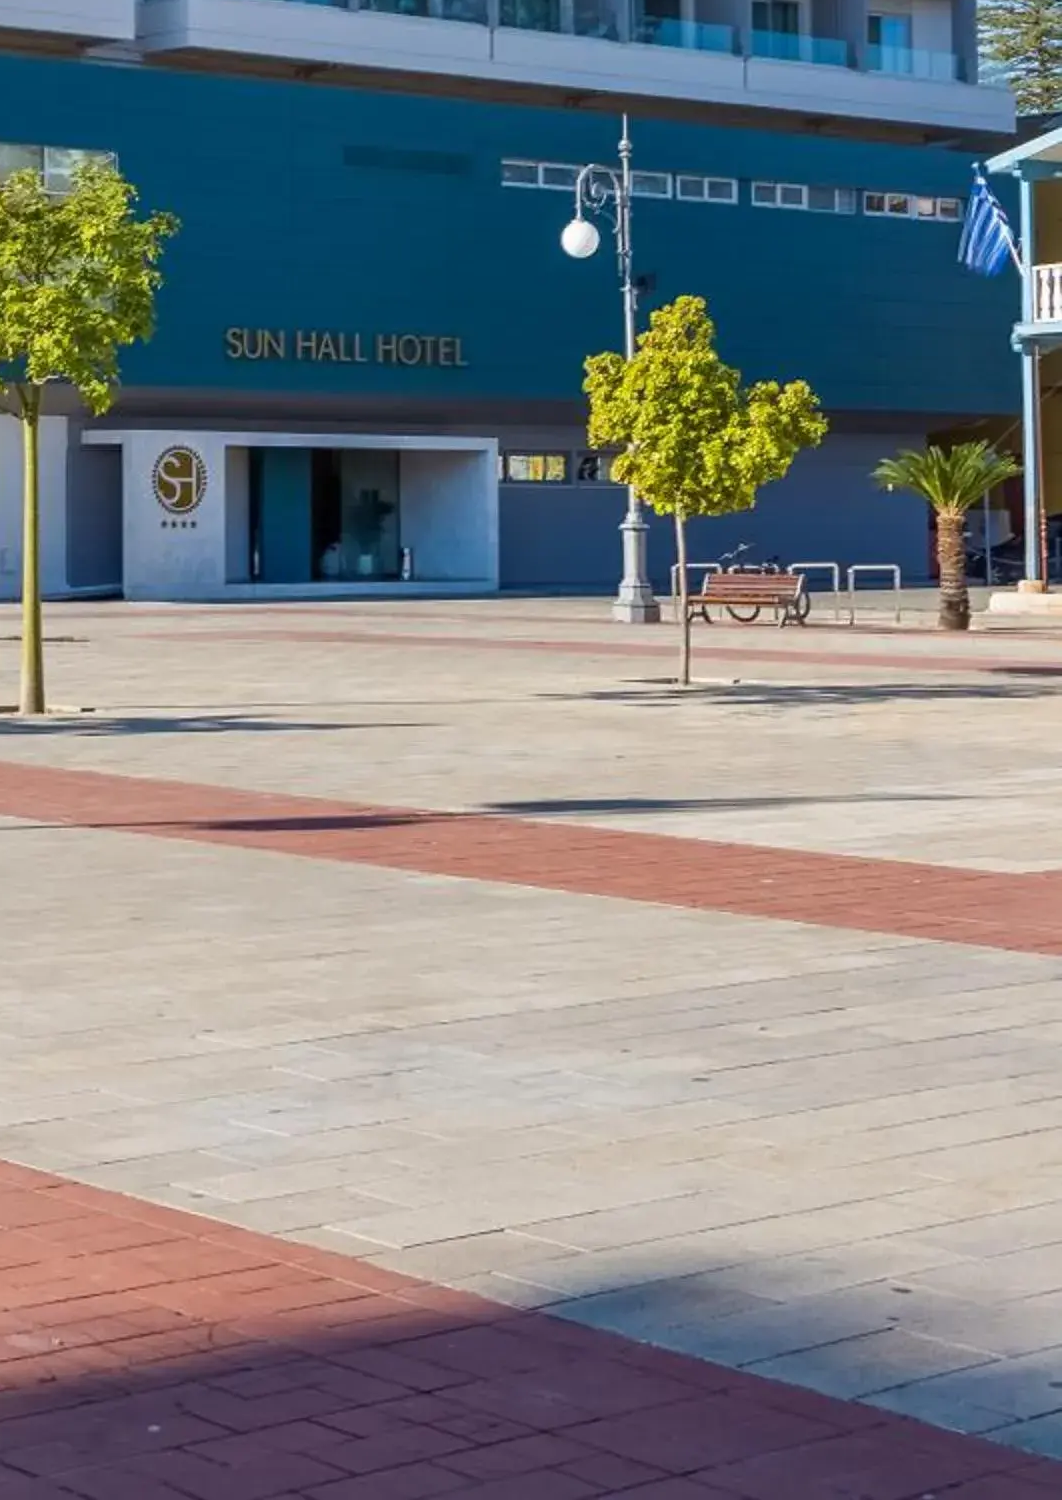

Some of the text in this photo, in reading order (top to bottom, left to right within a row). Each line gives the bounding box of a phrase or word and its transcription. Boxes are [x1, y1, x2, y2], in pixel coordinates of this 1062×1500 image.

[225, 327, 469, 367] SUN HALL HOTEL
